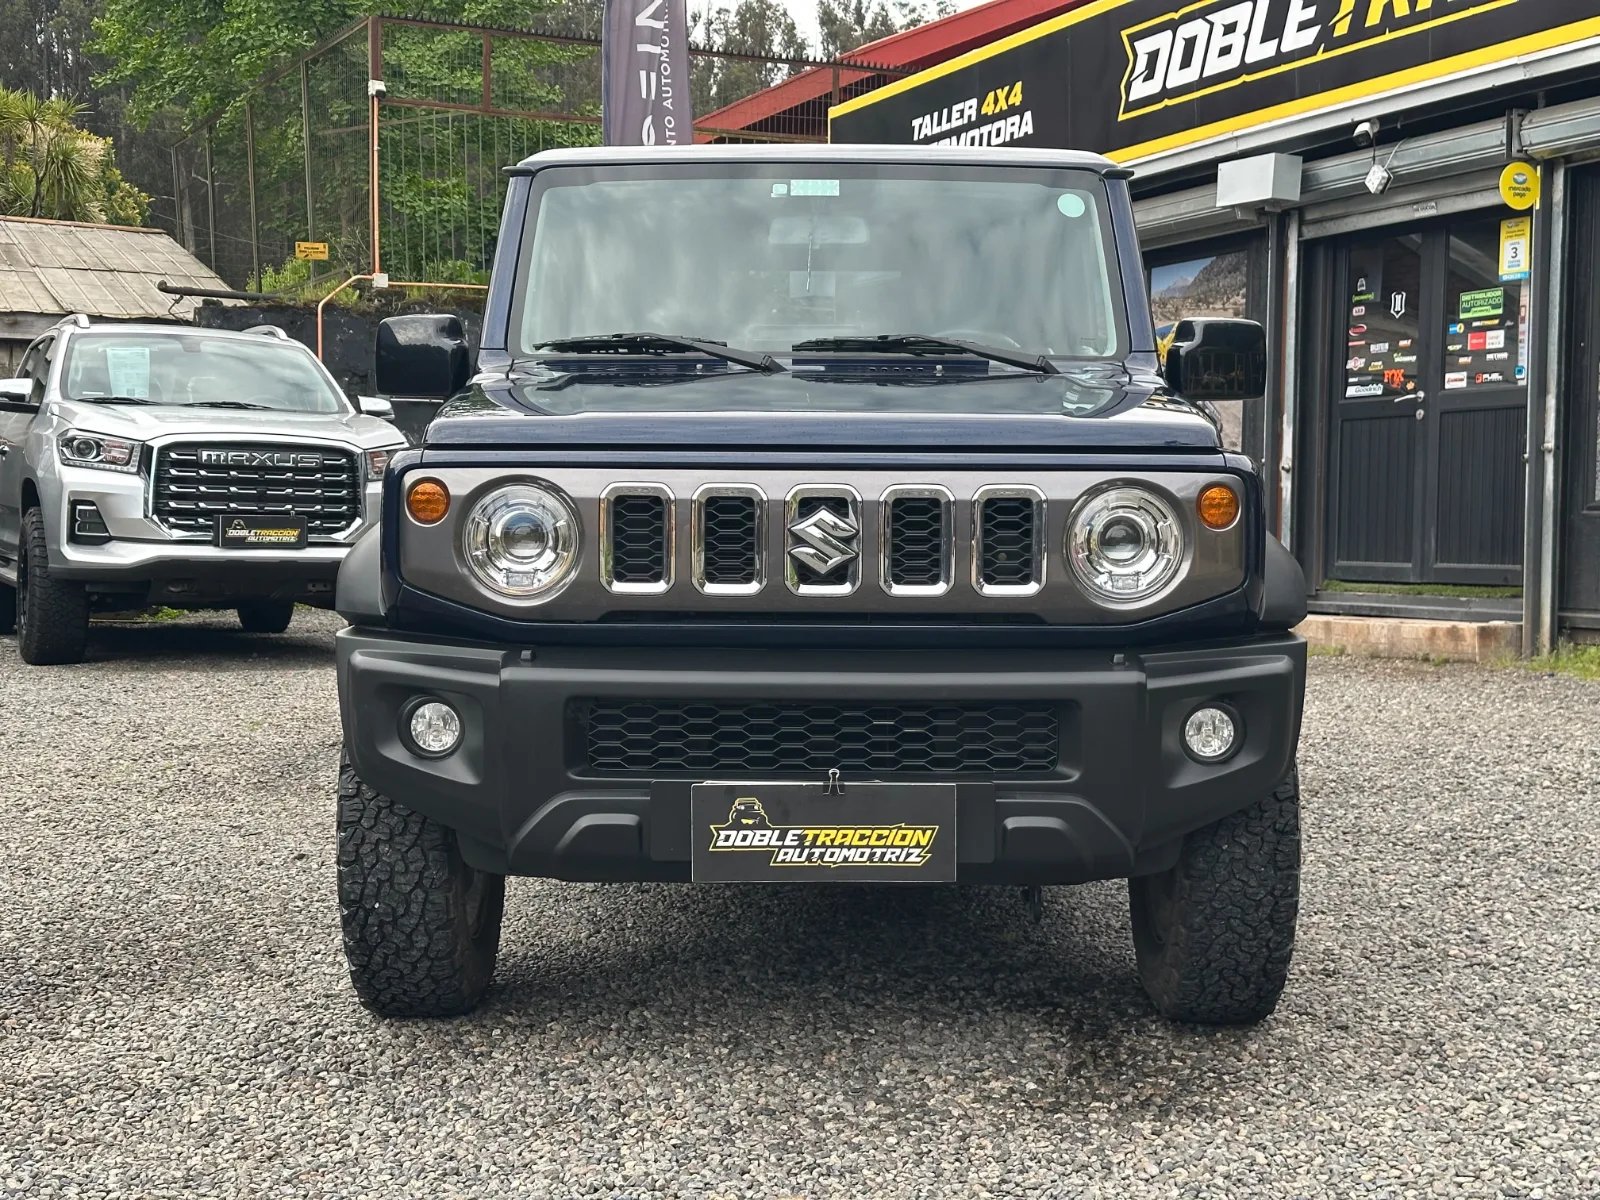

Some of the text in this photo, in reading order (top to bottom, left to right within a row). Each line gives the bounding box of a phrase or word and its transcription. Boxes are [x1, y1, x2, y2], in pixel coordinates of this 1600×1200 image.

[911, 80, 1023, 141] TALLER 4X4
[1510, 246, 1518, 259] 3
[1461, 290, 1502, 302] DISTRIBUIDOR
[1461, 297, 1502, 309] AUTORIZADO
[1383, 368, 1405, 389] FOX
[201, 450, 320, 467] MAXUS
[775, 848, 924, 863] AUTOMOTRIZ
